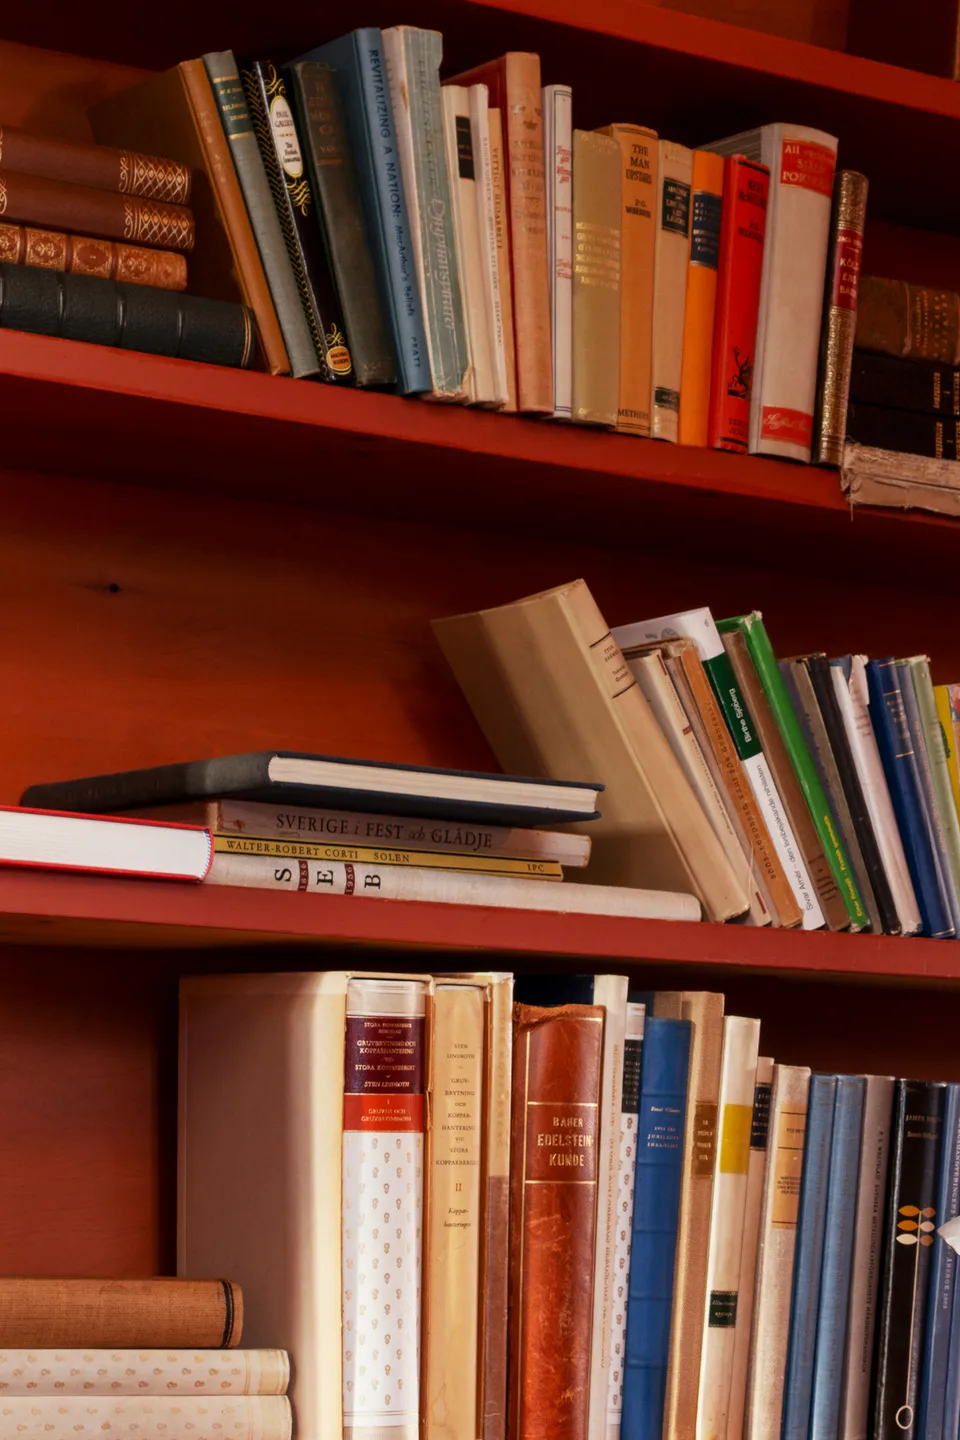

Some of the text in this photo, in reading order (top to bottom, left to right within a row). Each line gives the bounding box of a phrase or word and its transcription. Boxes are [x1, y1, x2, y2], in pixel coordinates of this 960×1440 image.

[632, 144, 649, 157] THE
[630, 157, 650, 170] MAN
[369, 49, 421, 368] REVITALIZING A NATION: MacArthur's Beliefs PRATT
[728, 687, 753, 744] Birthe Sjöberg
[276, 813, 493, 852] SVERIGE i FEST och GLÄDJE
[227, 840, 545, 872] WALTER-ROBERT CORTI SOLEN IPC
[786, 847, 797, 863] den
[274, 867, 292, 882] S
[316, 869, 334, 886] E
[364, 873, 382, 890] B
[801, 891, 814, 911] Sivar
[445, 1089, 476, 1097] BRYTNING
[441, 1124, 477, 1132] HANTERING
[537, 1133, 594, 1148] EDELSTEIN-
[549, 1153, 585, 1168] KUNDE
[455, 1182, 463, 1193] II
